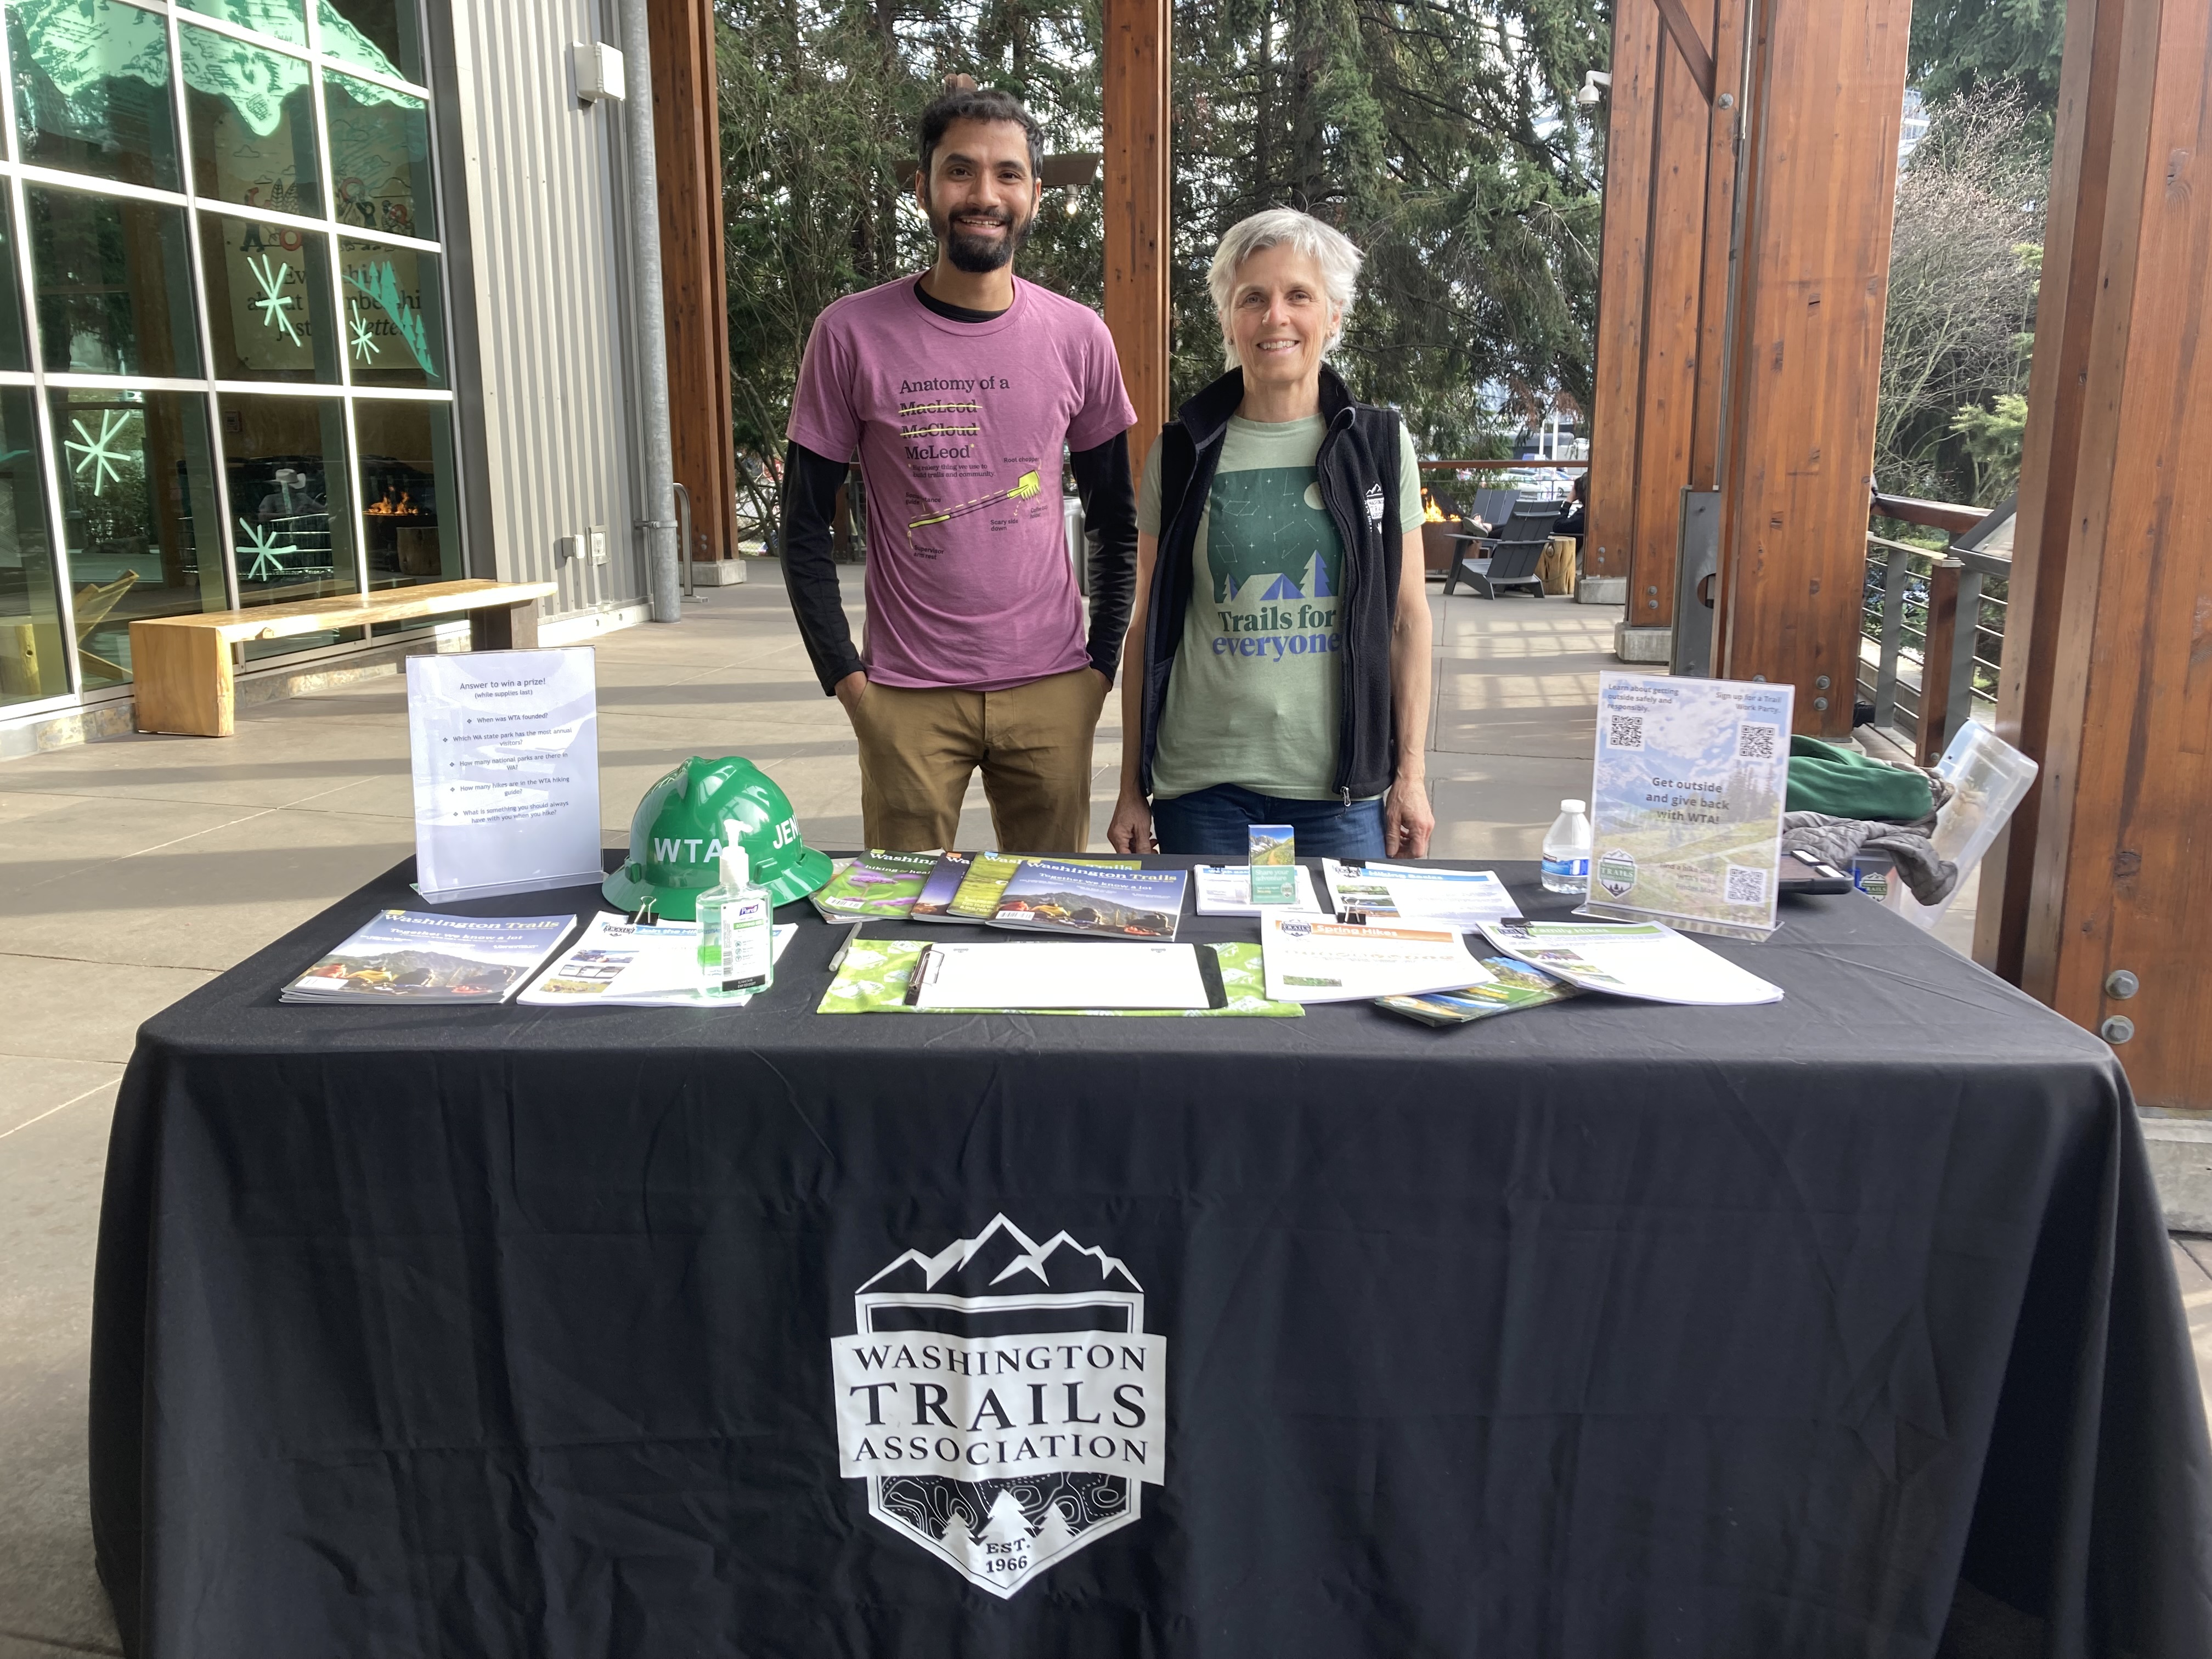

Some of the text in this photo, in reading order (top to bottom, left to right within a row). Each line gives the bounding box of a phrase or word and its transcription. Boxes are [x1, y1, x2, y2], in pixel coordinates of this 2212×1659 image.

[276, 319, 312, 341] jst
[899, 376, 1010, 394] Anatomy of a
[900, 399, 978, 417] MacLeod
[901, 422, 978, 439] McCloud
[904, 445, 970, 459] McLeod
[914, 545, 944, 554] Supervisor
[1217, 604, 1336, 632] Trails for
[1212, 632, 1342, 662] everyone
[460, 682, 488, 690] Answer
[524, 678, 546, 687] prize!
[1652, 687, 1679, 696] getting
[1635, 696, 1657, 704] safely
[1716, 692, 1731, 700] Sign
[1607, 703, 1650, 713] responsibly.
[1652, 777, 1723, 793] Get outside
[1646, 794, 1730, 810] and give back
[1657, 810, 1719, 825] with WTA!
[654, 837, 723, 863] WTA
[870, 852, 938, 866] Washing
[864, 865, 898, 873] hiking
[1028, 863, 1127, 879] Washington
[1369, 870, 1407, 879] Hiking
[1601, 867, 1633, 878] TRAILS
[1039, 872, 1084, 882] Together
[384, 914, 560, 929] Washington Trails
[390, 928, 441, 936] Together
[1317, 925, 1398, 936] Spring Hikes
[853, 1344, 1147, 1376] WASHINGTON
[849, 1381, 1147, 1432] TRAILS
[853, 1434, 1148, 1465] ASSOCIATION
[986, 1538, 1031, 1555] EST.
[986, 1555, 1028, 1573] 1966
